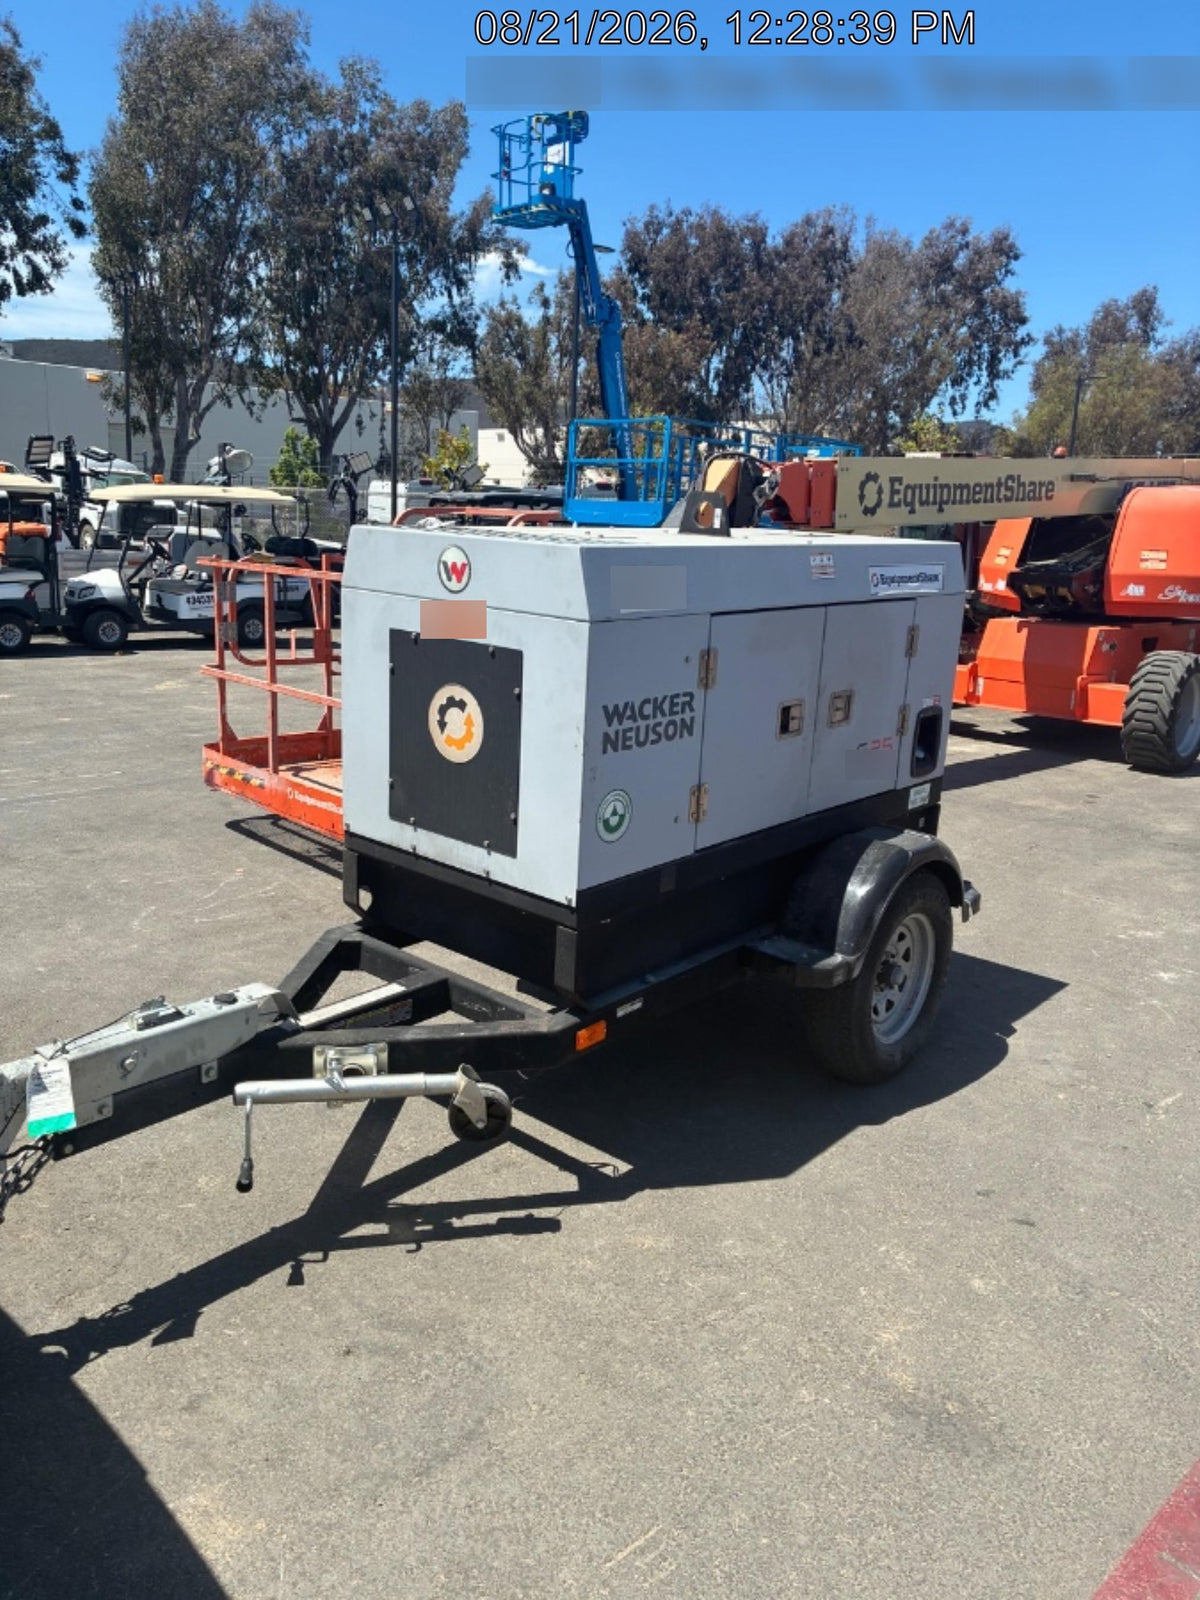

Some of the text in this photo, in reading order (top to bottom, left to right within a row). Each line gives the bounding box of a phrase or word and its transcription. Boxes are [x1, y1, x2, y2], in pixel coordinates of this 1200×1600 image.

[887, 474, 1056, 515] EquipmentShare
[601, 690, 696, 728] WACKER
[601, 715, 696, 755] NEUSON
